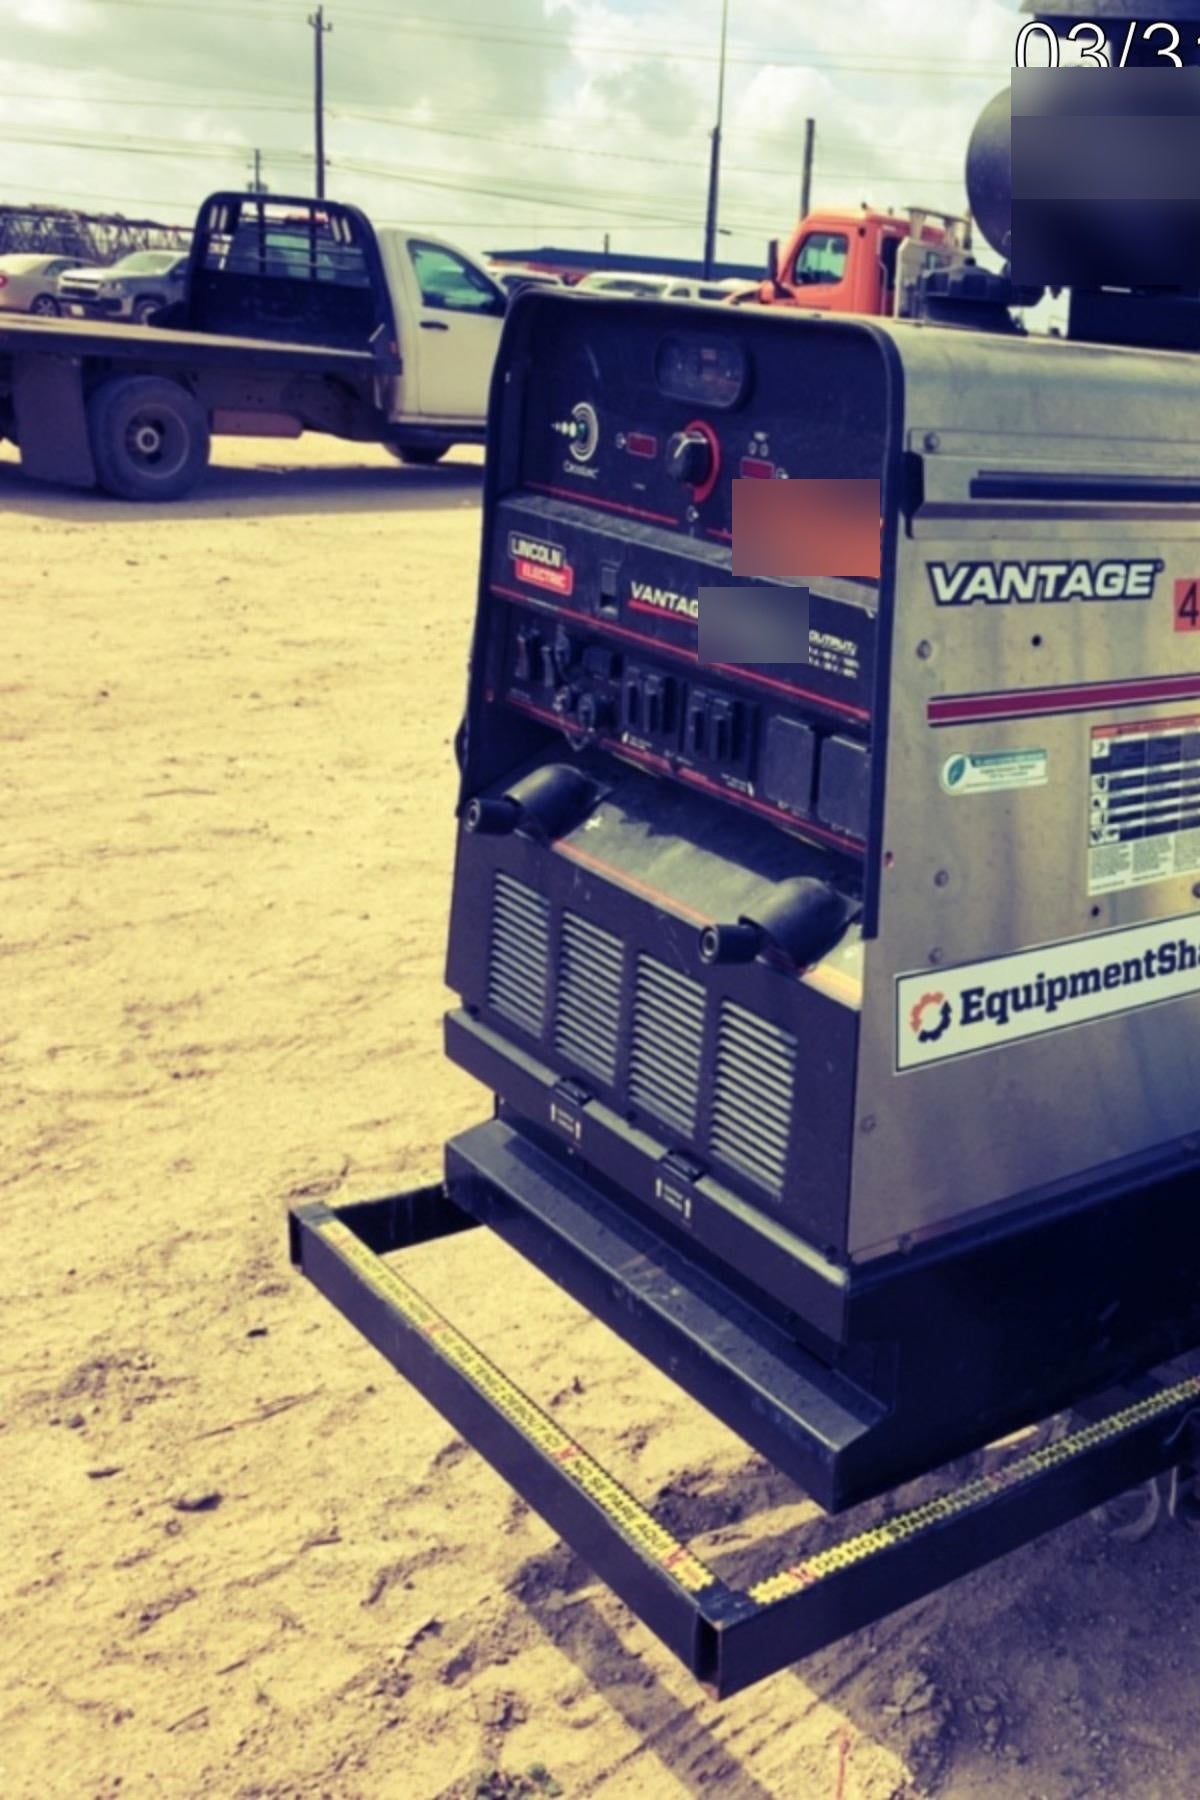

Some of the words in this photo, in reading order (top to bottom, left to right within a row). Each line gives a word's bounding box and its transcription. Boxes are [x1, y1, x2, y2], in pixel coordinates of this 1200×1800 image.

[511, 538, 562, 568] LINCOLN
[630, 580, 699, 619] VANTAG
[928, 561, 1156, 605] VANTAGE
